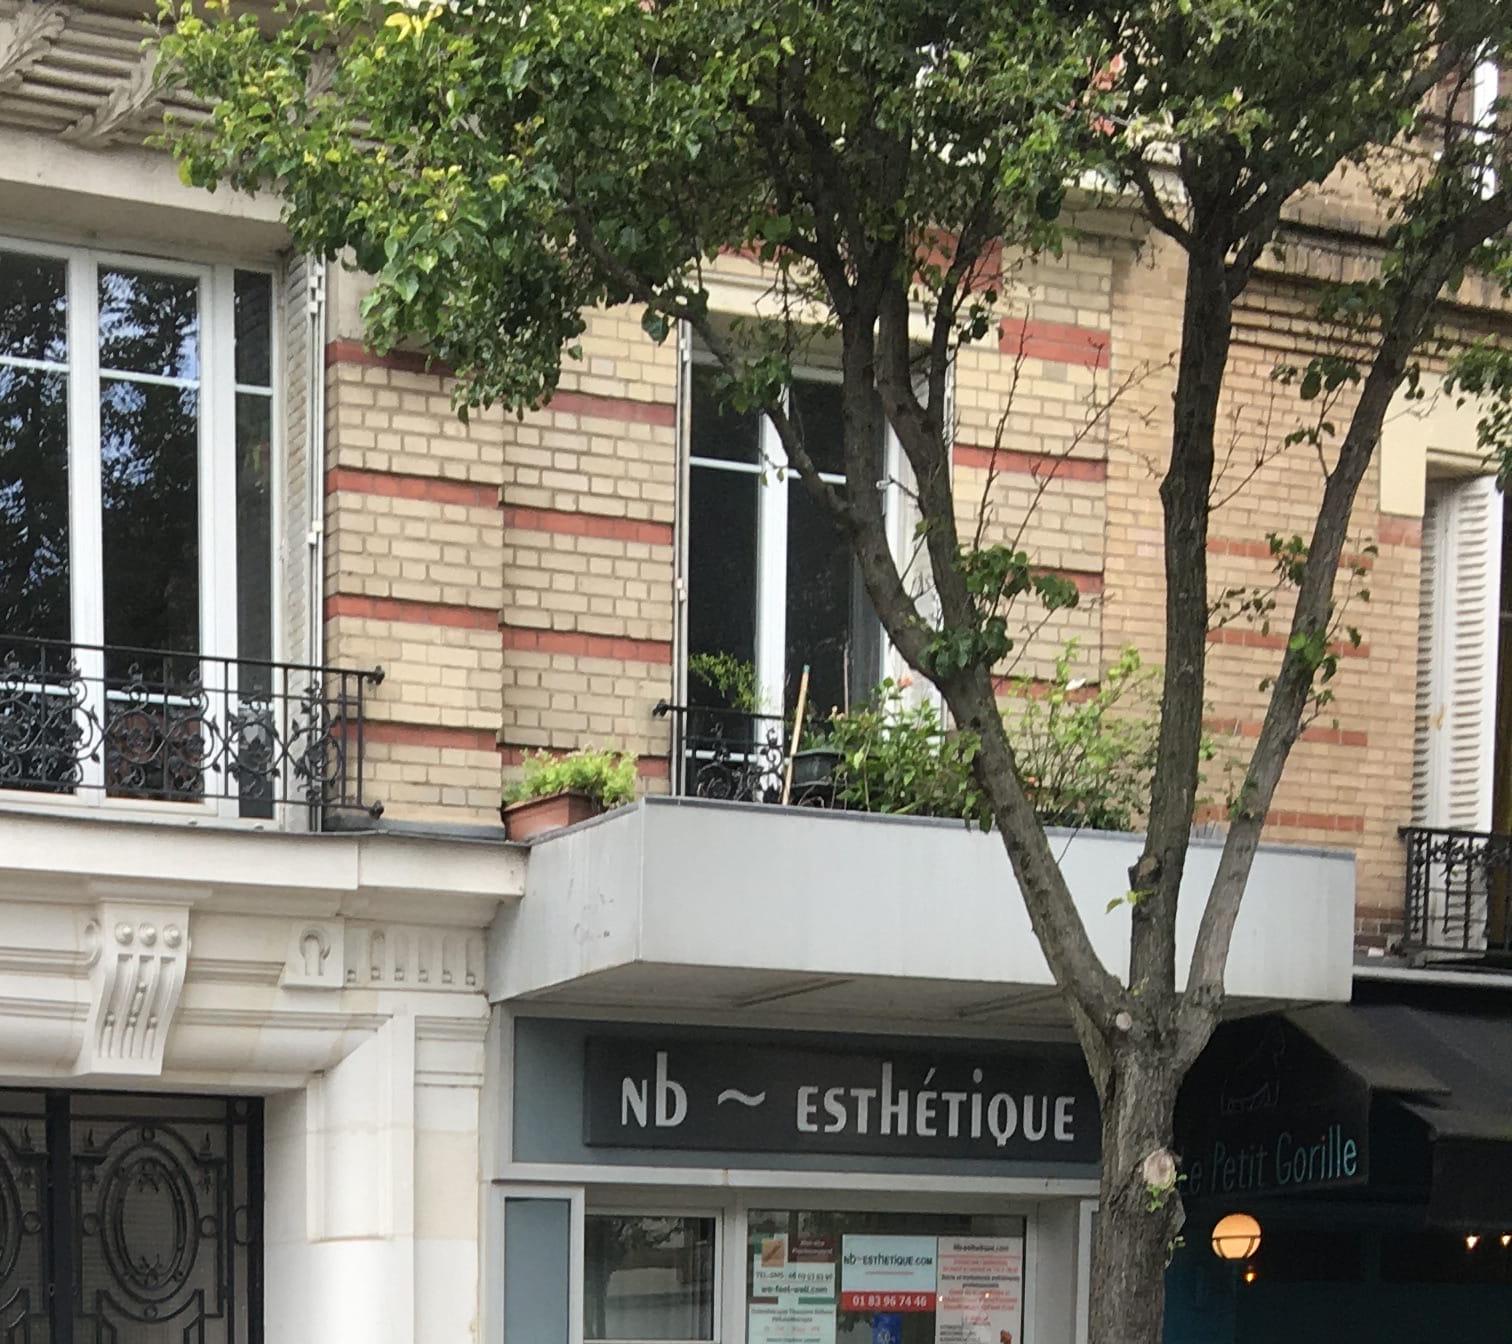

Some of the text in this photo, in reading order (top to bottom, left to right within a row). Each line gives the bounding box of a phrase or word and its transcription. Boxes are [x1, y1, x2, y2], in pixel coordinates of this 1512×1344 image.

[1210, 1140, 1268, 1192] Petit
[1275, 1122, 1358, 1185] Gorille
[852, 1295, 865, 1306] 01
